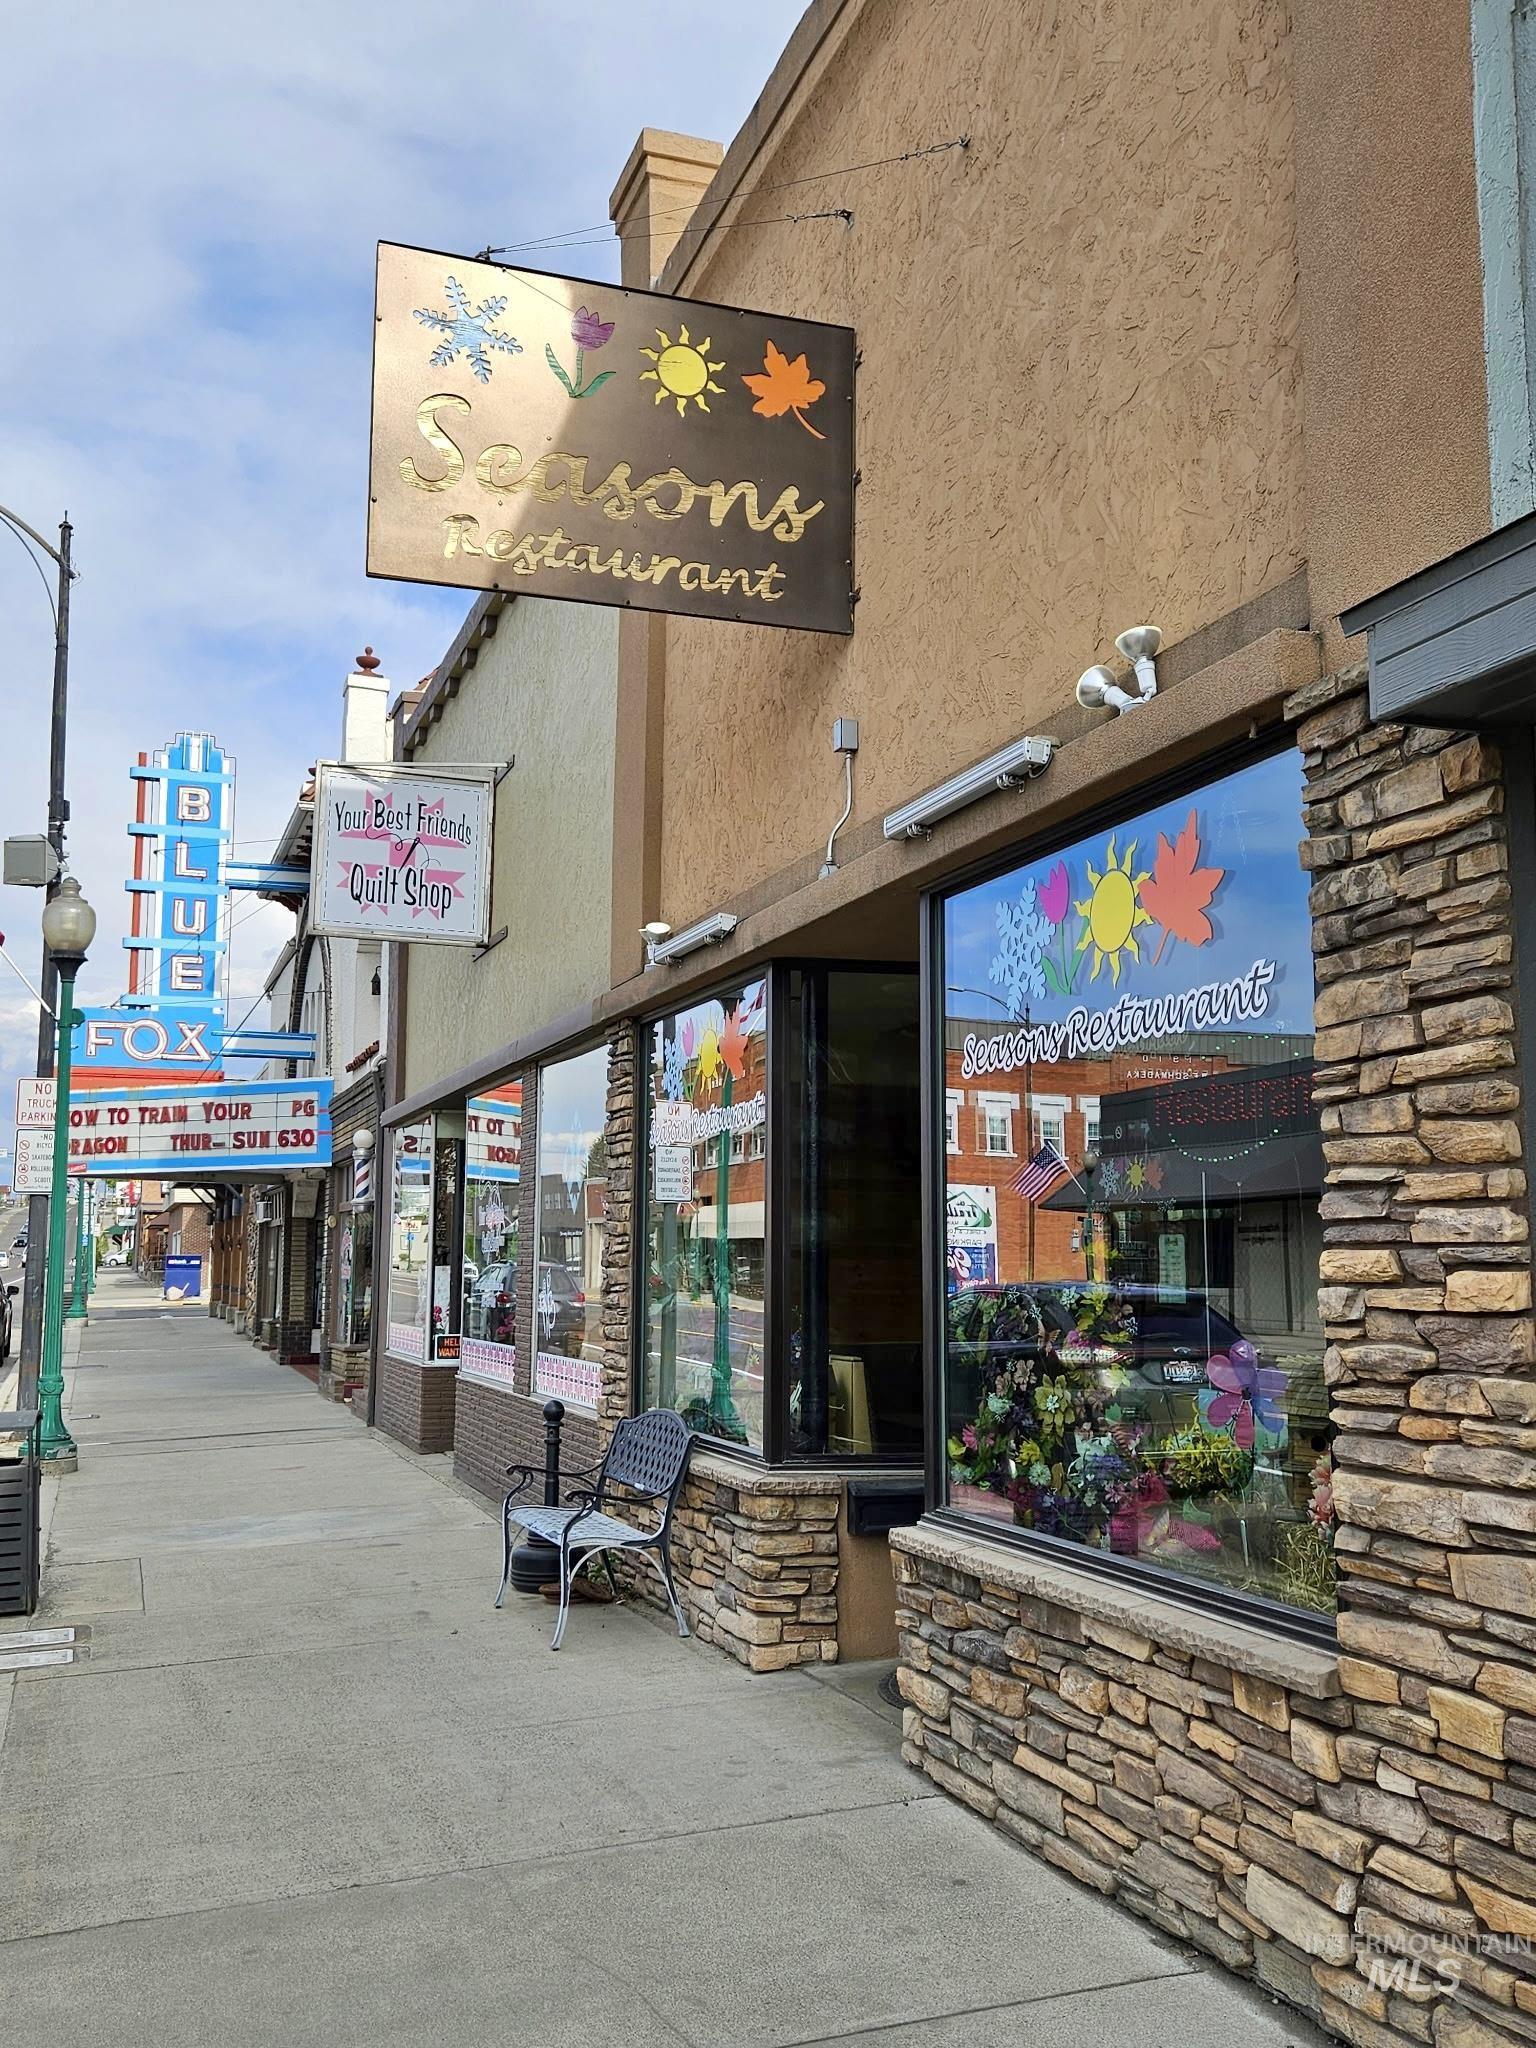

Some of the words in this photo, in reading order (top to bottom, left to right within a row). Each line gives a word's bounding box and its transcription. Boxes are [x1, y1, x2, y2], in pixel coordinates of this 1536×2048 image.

[398, 393, 825, 543] Seasons
[442, 513, 786, 602] Restaurant
[335, 801, 368, 832] Your
[374, 799, 412, 831] Best
[417, 803, 472, 845] Friends
[171, 785, 212, 990] BLUE
[350, 863, 399, 904] Quilt
[404, 867, 452, 918] Shop
[86, 1018, 213, 1062] FOX
[961, 1021, 1066, 1080] Seasons
[1066, 958, 1276, 1059] Restaurant
[35, 1083, 52, 1095] NO
[21, 1112, 56, 1121] PARKIN
[70, 1109, 100, 1127] OW
[108, 1107, 130, 1125] TO
[138, 1105, 188, 1124] TRAIN
[202, 1102, 252, 1123] YOUR
[292, 1099, 315, 1117] PG
[692, 1090, 766, 1138] Restaurant
[69, 1136, 128, 1155] RAGON
[170, 1133, 225, 1151] THUR-
[233, 1131, 270, 1149] SUN
[278, 1129, 315, 1147] 630
[438, 1347, 460, 1357] WANT
[444, 1337, 459, 1347] HEL
